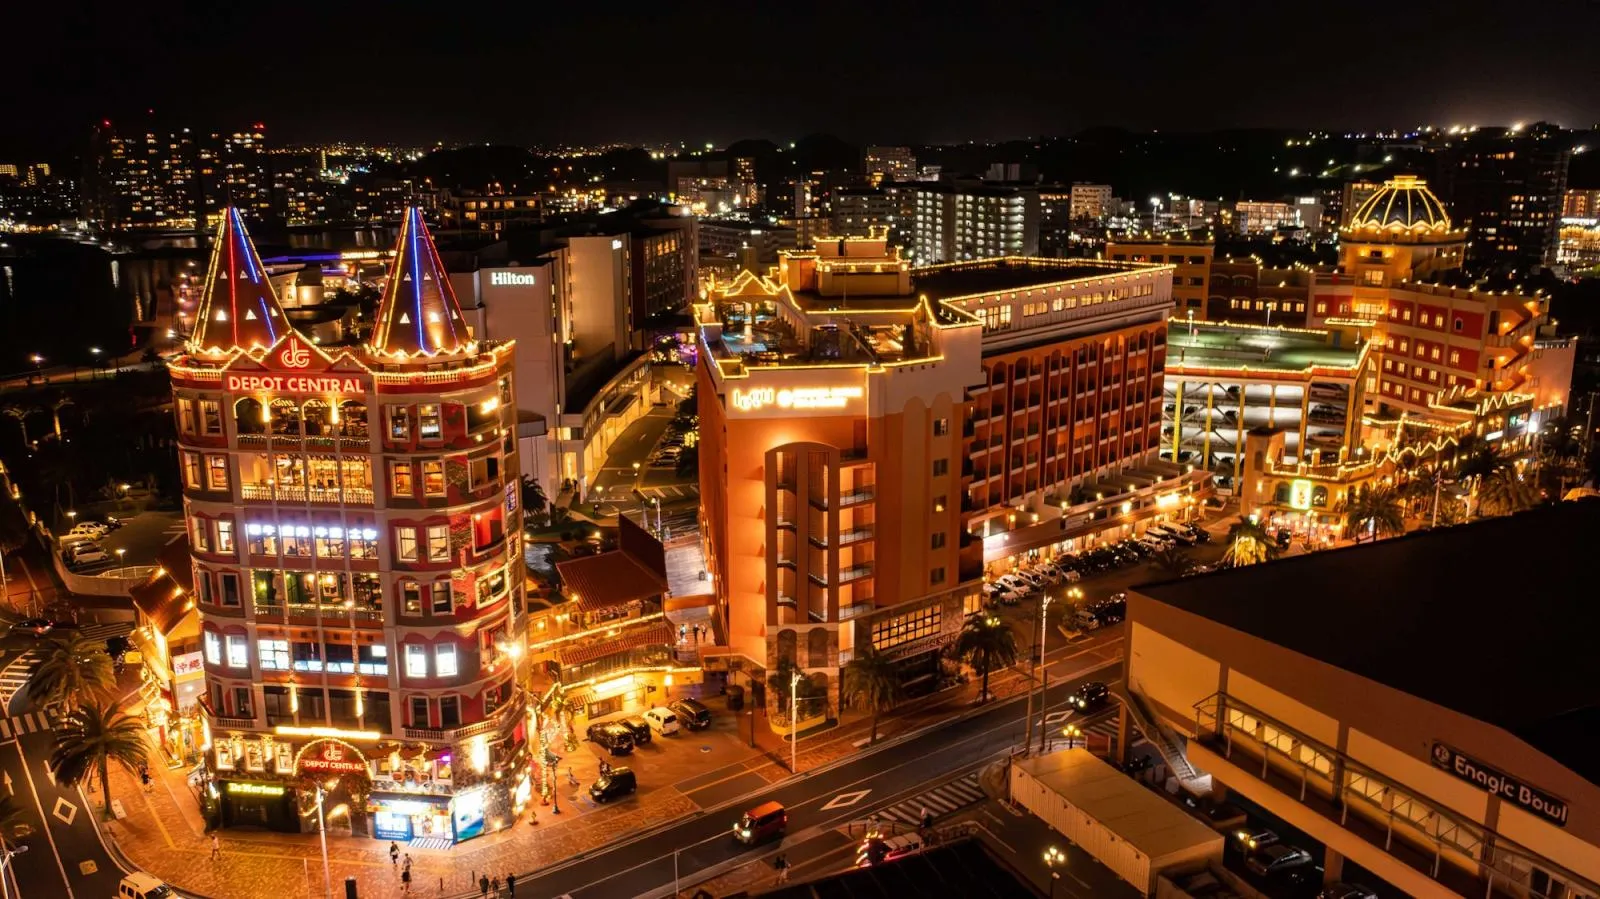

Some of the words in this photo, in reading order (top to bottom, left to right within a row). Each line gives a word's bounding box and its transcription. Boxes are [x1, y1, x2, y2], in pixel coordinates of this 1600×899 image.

[491, 272, 535, 285] Hilton
[228, 376, 284, 391] DEPOT
[287, 377, 365, 393] CENTRAL
[308, 454, 367, 462] FRANISCO
[304, 760, 329, 769] DEPOT
[330, 762, 364, 771] CENTRAL
[1455, 755, 1515, 797] Enagic
[1519, 785, 1568, 822] Bowl
